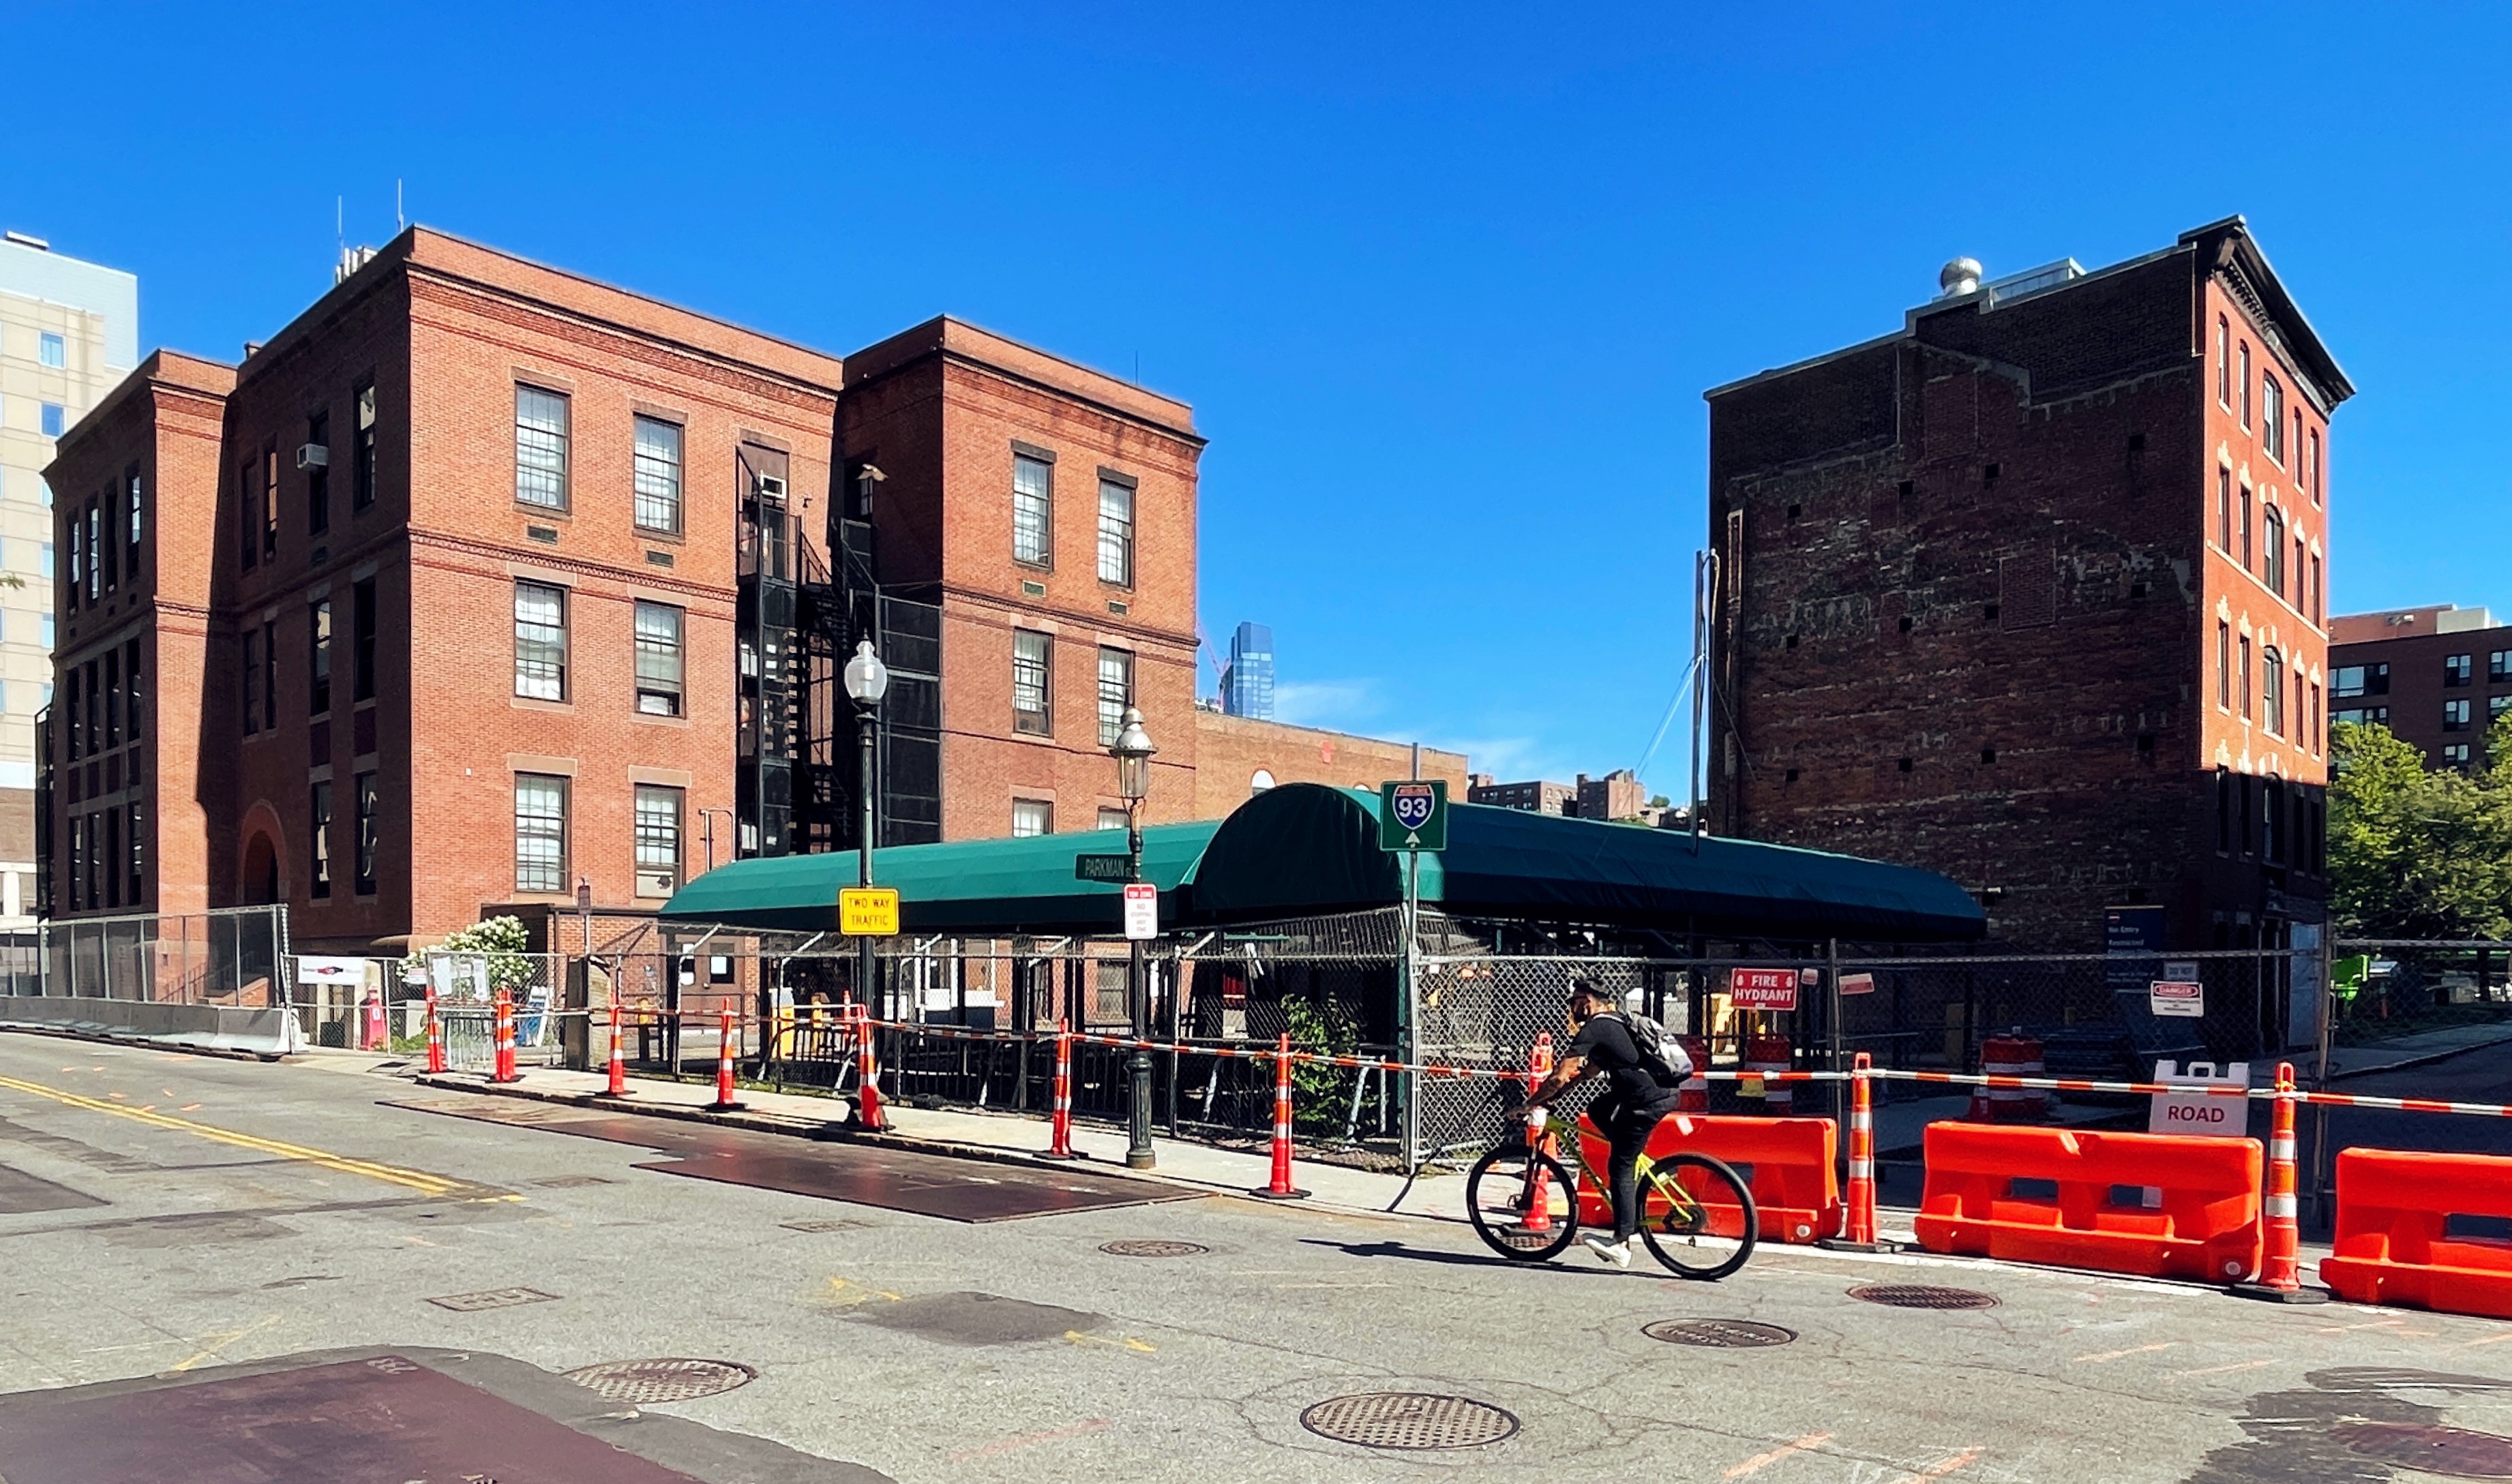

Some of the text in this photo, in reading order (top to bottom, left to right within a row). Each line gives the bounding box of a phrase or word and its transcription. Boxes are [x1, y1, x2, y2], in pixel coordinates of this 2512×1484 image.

[1399, 798, 1426, 817] 93
[1086, 859, 1124, 877] PARKMAN
[848, 897, 891, 909] TWO WAY
[851, 915, 888, 926] TRAFFIC
[1752, 975, 1778, 987] FIRE
[1735, 988, 1793, 1001] HYDRANT
[2159, 986, 2192, 995] DANGER
[2168, 1106, 2225, 1123] ROAD
